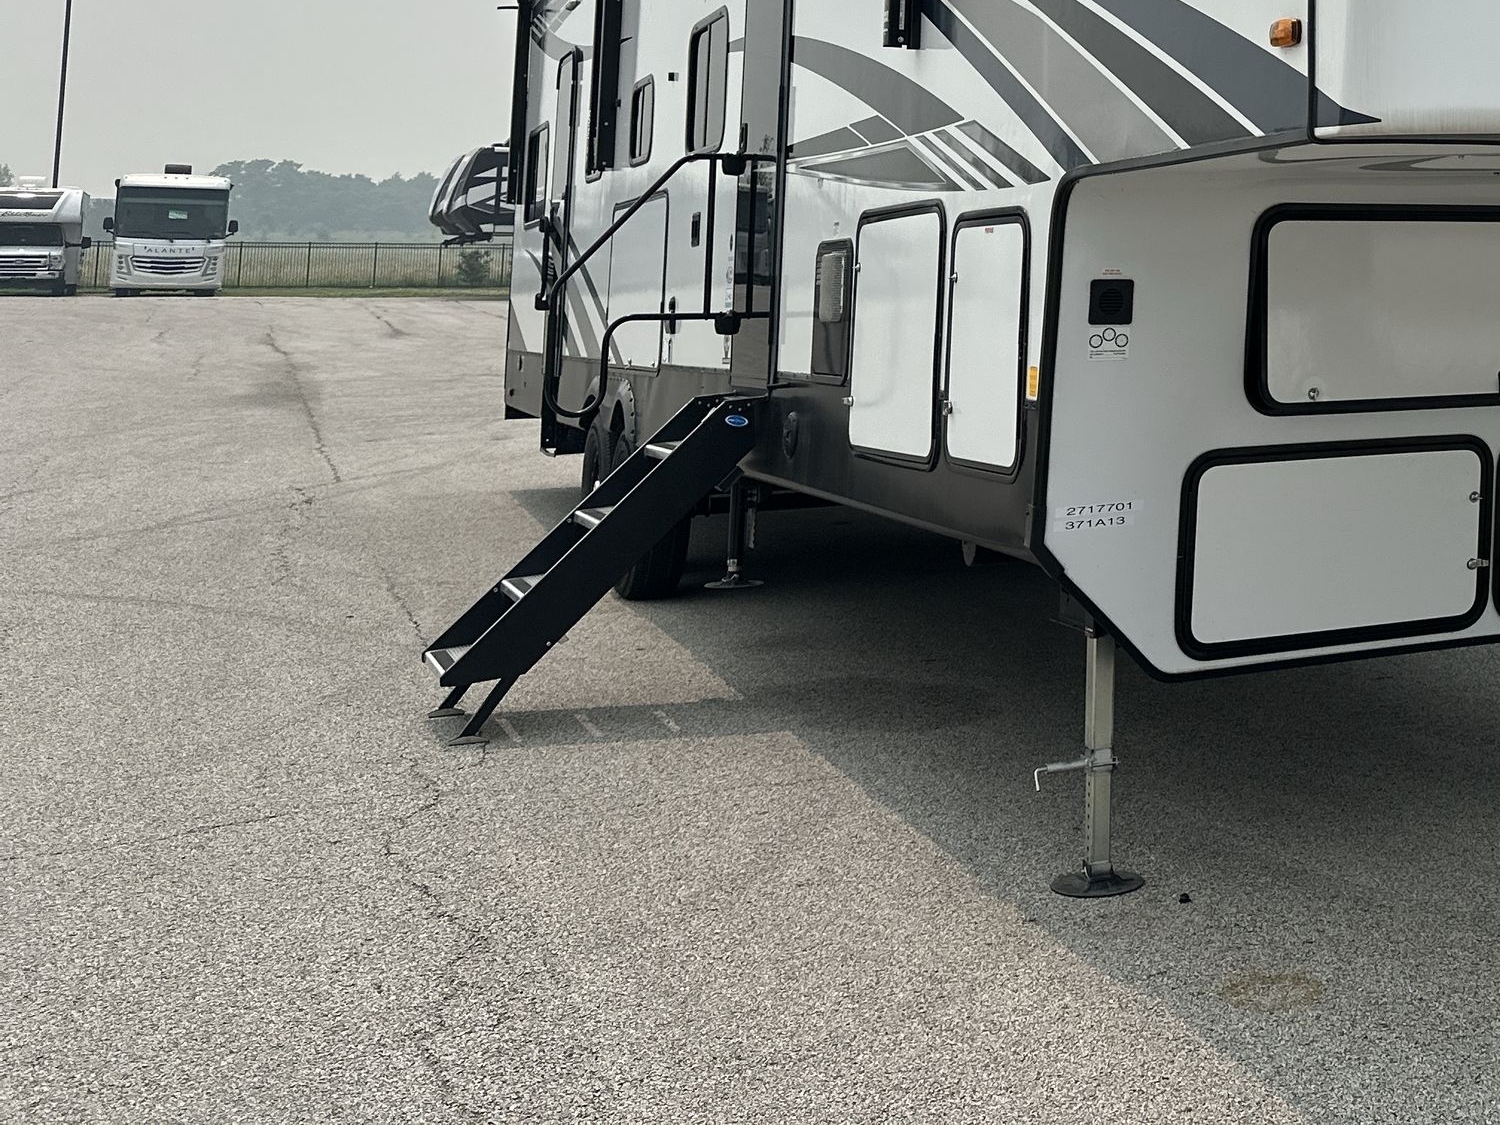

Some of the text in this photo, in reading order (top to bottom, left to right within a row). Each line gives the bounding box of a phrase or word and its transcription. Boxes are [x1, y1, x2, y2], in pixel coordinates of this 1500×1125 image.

[145, 246, 192, 254] ALANTE
[1066, 501, 1132, 516] 2717701
[1065, 516, 1126, 530] 371A13
